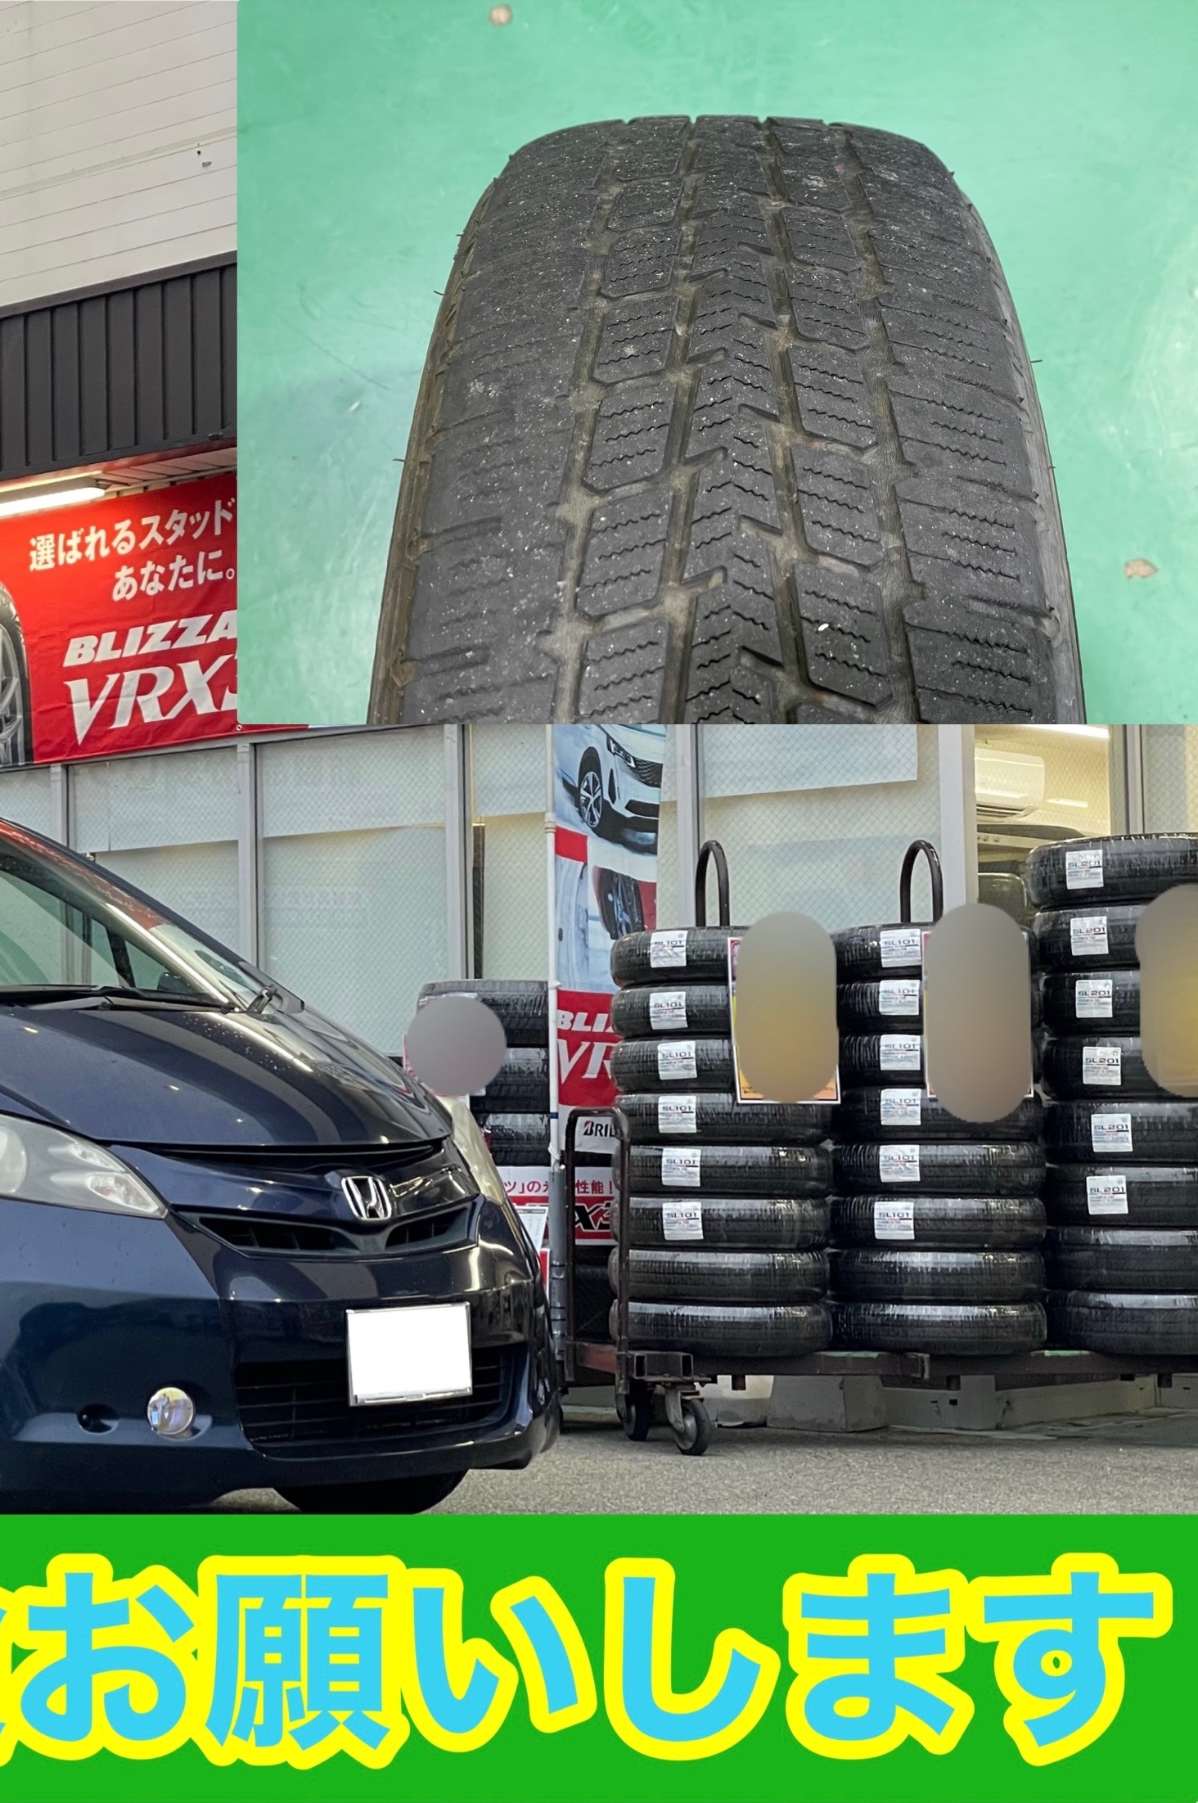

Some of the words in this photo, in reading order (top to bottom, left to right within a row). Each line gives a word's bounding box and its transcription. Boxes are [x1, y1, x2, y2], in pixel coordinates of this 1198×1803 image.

[29, 497, 236, 571] 選ばれるスタッド
[112, 549, 236, 602] あなたに。
